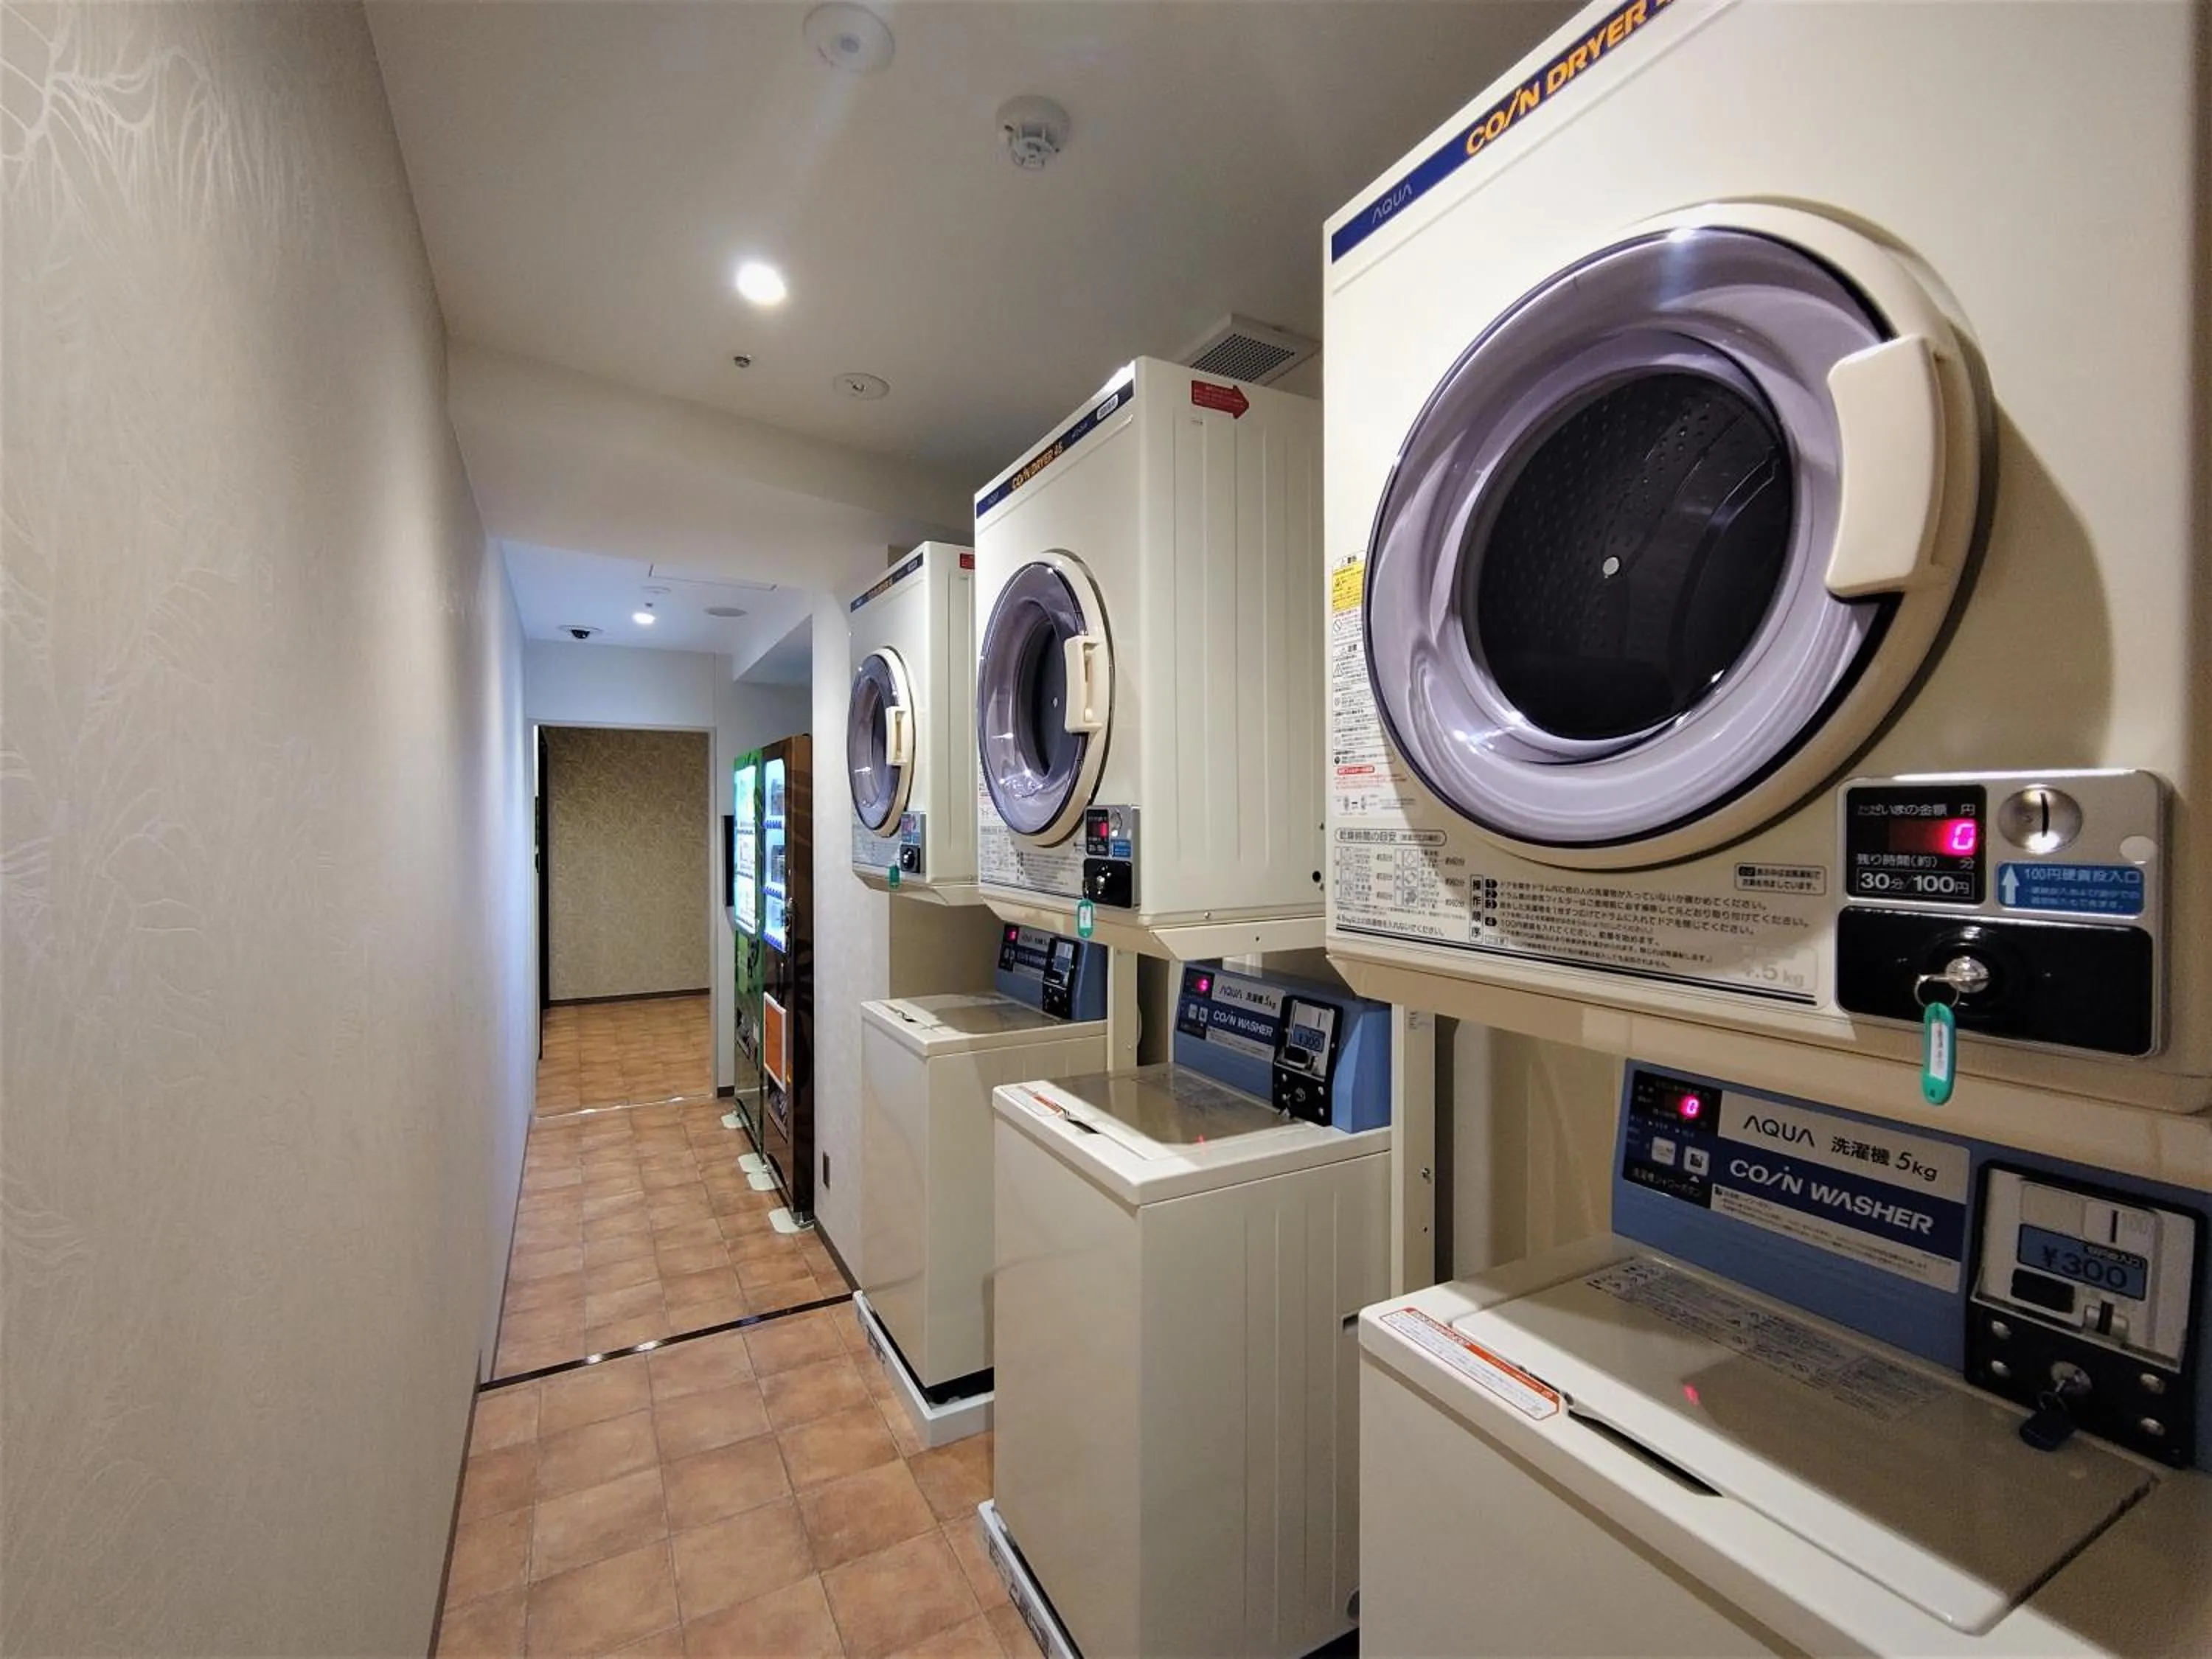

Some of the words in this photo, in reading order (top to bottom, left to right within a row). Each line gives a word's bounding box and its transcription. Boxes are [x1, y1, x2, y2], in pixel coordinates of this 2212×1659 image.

[1372, 184, 1413, 224] AQUA
[1547, 0, 1647, 94] DRYER
[1960, 803, 1975, 816] 円
[1952, 822, 1975, 850] 0
[1959, 857, 1975, 870] 分
[2025, 867, 2139, 884] 100円硬貨投入口
[1783, 970, 1805, 987] kg
[1237, 1018, 1274, 1037] WASHER
[1686, 1099, 1700, 1116] 0
[1743, 1115, 1815, 1148] AQUA
[1831, 1135, 1891, 1166] 洗濯機
[1894, 1152, 1938, 1183] 5kg
[1809, 1182, 1935, 1236] WASHER
[2041, 1245, 2128, 1290] ¥300
